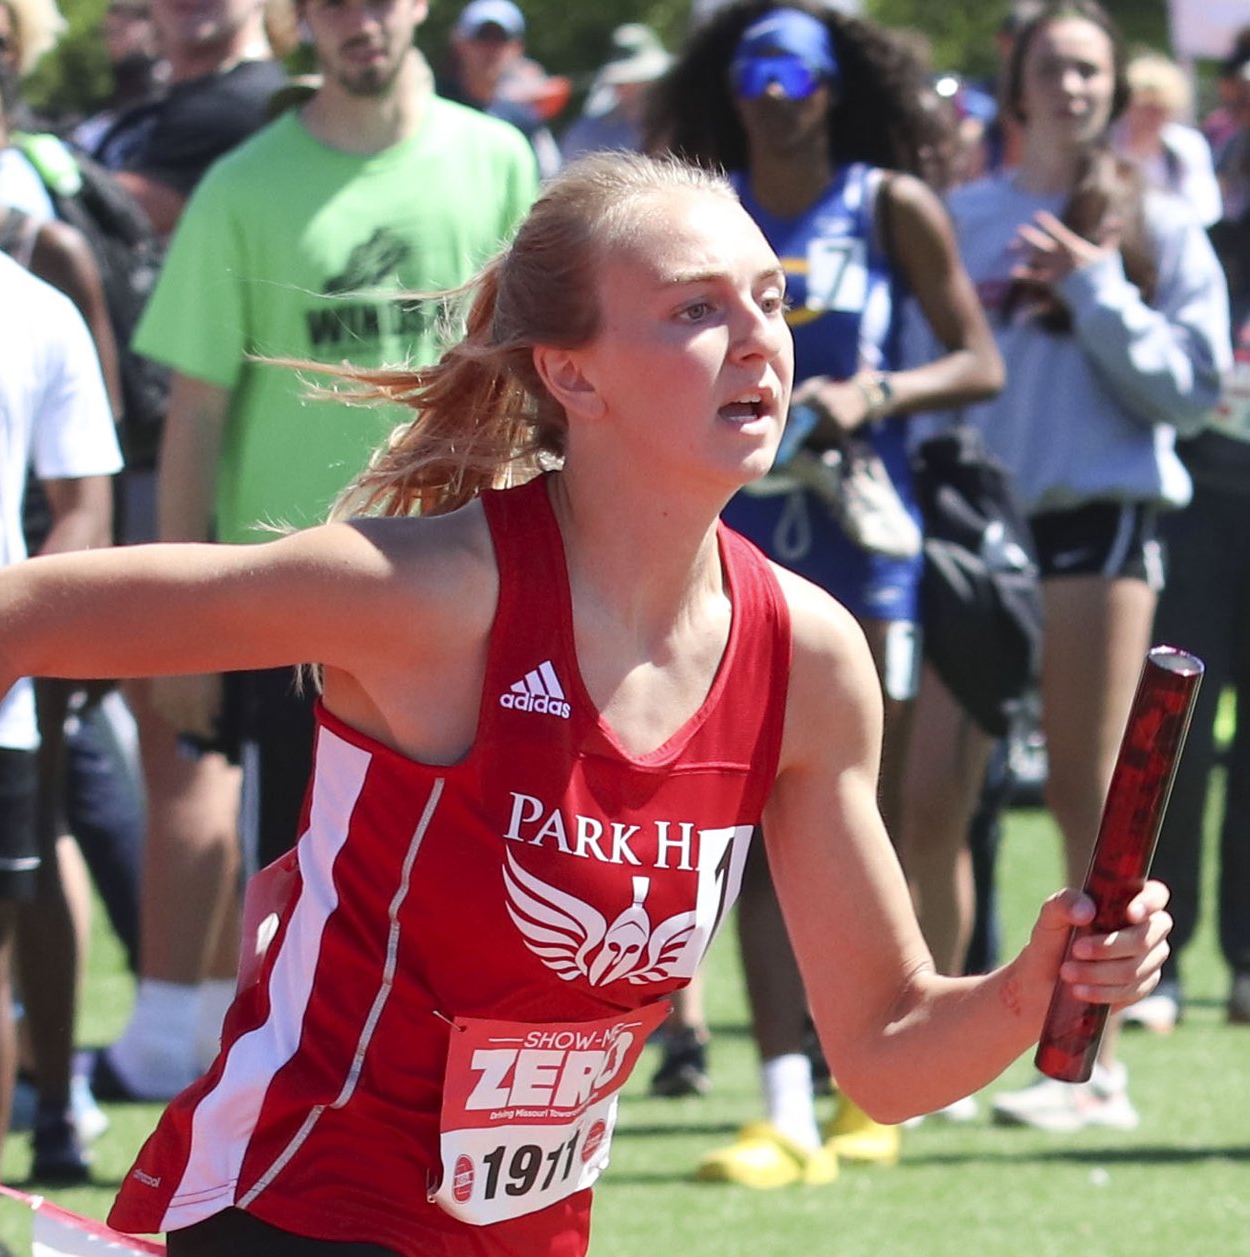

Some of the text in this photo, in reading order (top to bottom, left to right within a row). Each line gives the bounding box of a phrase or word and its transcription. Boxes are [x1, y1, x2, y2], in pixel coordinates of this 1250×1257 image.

[821, 245, 854, 310] 7
[500, 692, 571, 719] adidas
[503, 791, 699, 872] PARK H
[465, 1031, 634, 1111] ZERO
[490, 1110, 514, 1120] Driving
[515, 1109, 548, 1118] Missouri
[483, 1129, 581, 1200] 1911
